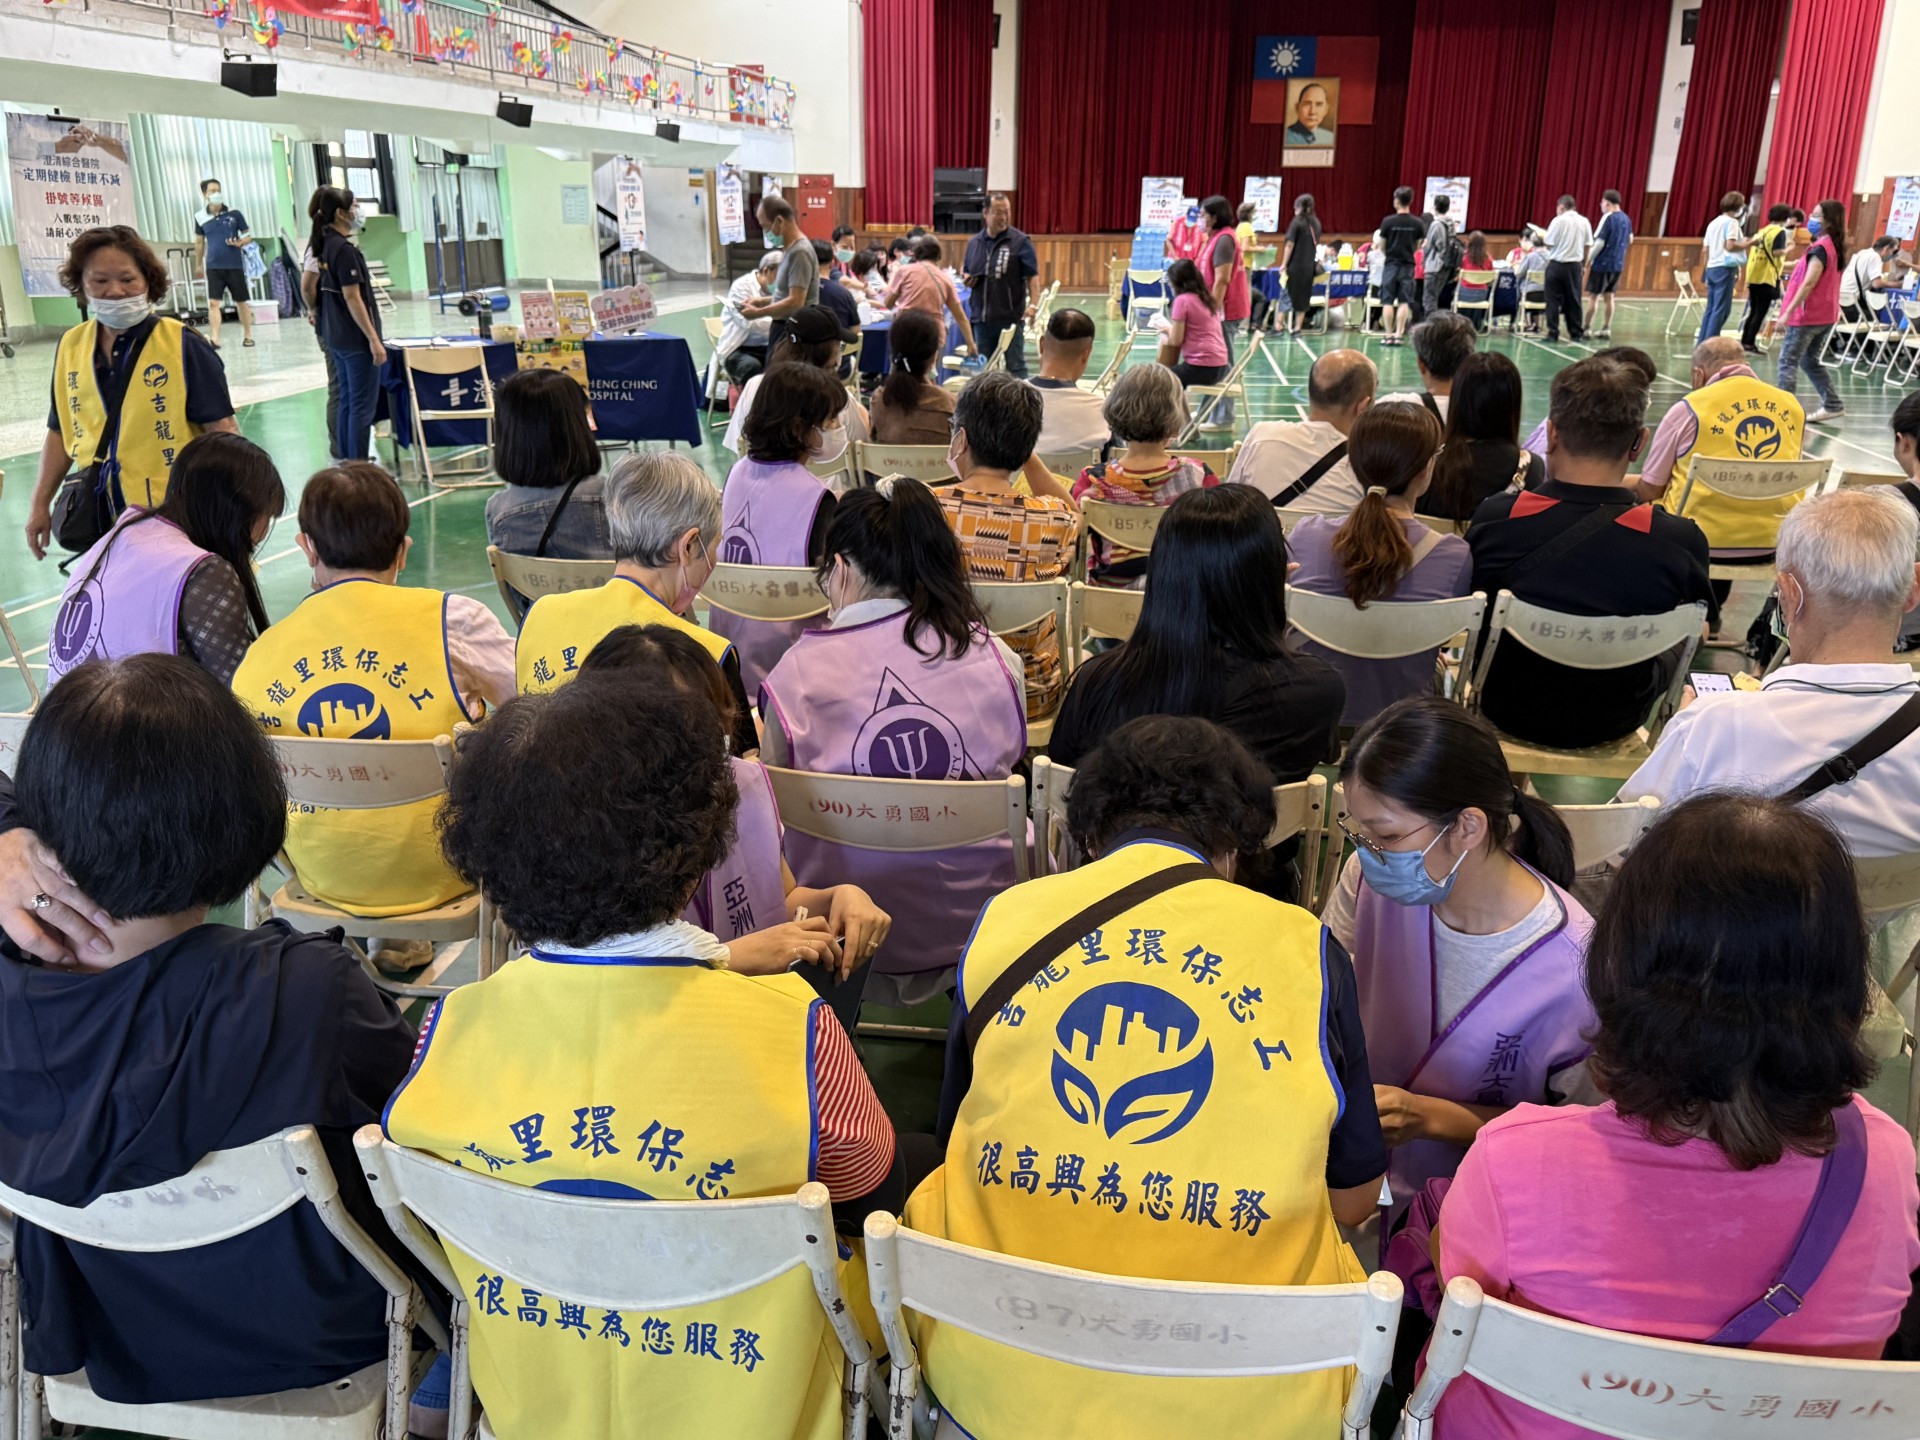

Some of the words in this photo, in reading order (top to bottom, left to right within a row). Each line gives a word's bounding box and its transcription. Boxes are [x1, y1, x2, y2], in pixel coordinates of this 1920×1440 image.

[23, 167, 71, 183] 定期健檢
[45, 191, 104, 207] 掛號等候區
[46, 227, 87, 239] 請耐心等
[589, 379, 619, 390] HENG
[622, 379, 658, 390] CHING
[589, 391, 635, 401] OSPITAL
[150, 393, 175, 467] 吉龍里
[1710, 398, 1796, 435] 吉龍里環保志工
[257, 646, 434, 729] 吉龍里環保志工
[722, 876, 756, 938] 亞洲
[977, 1140, 1272, 1237] 很高興為您服務
[474, 1273, 765, 1373] 很高興為您服務
